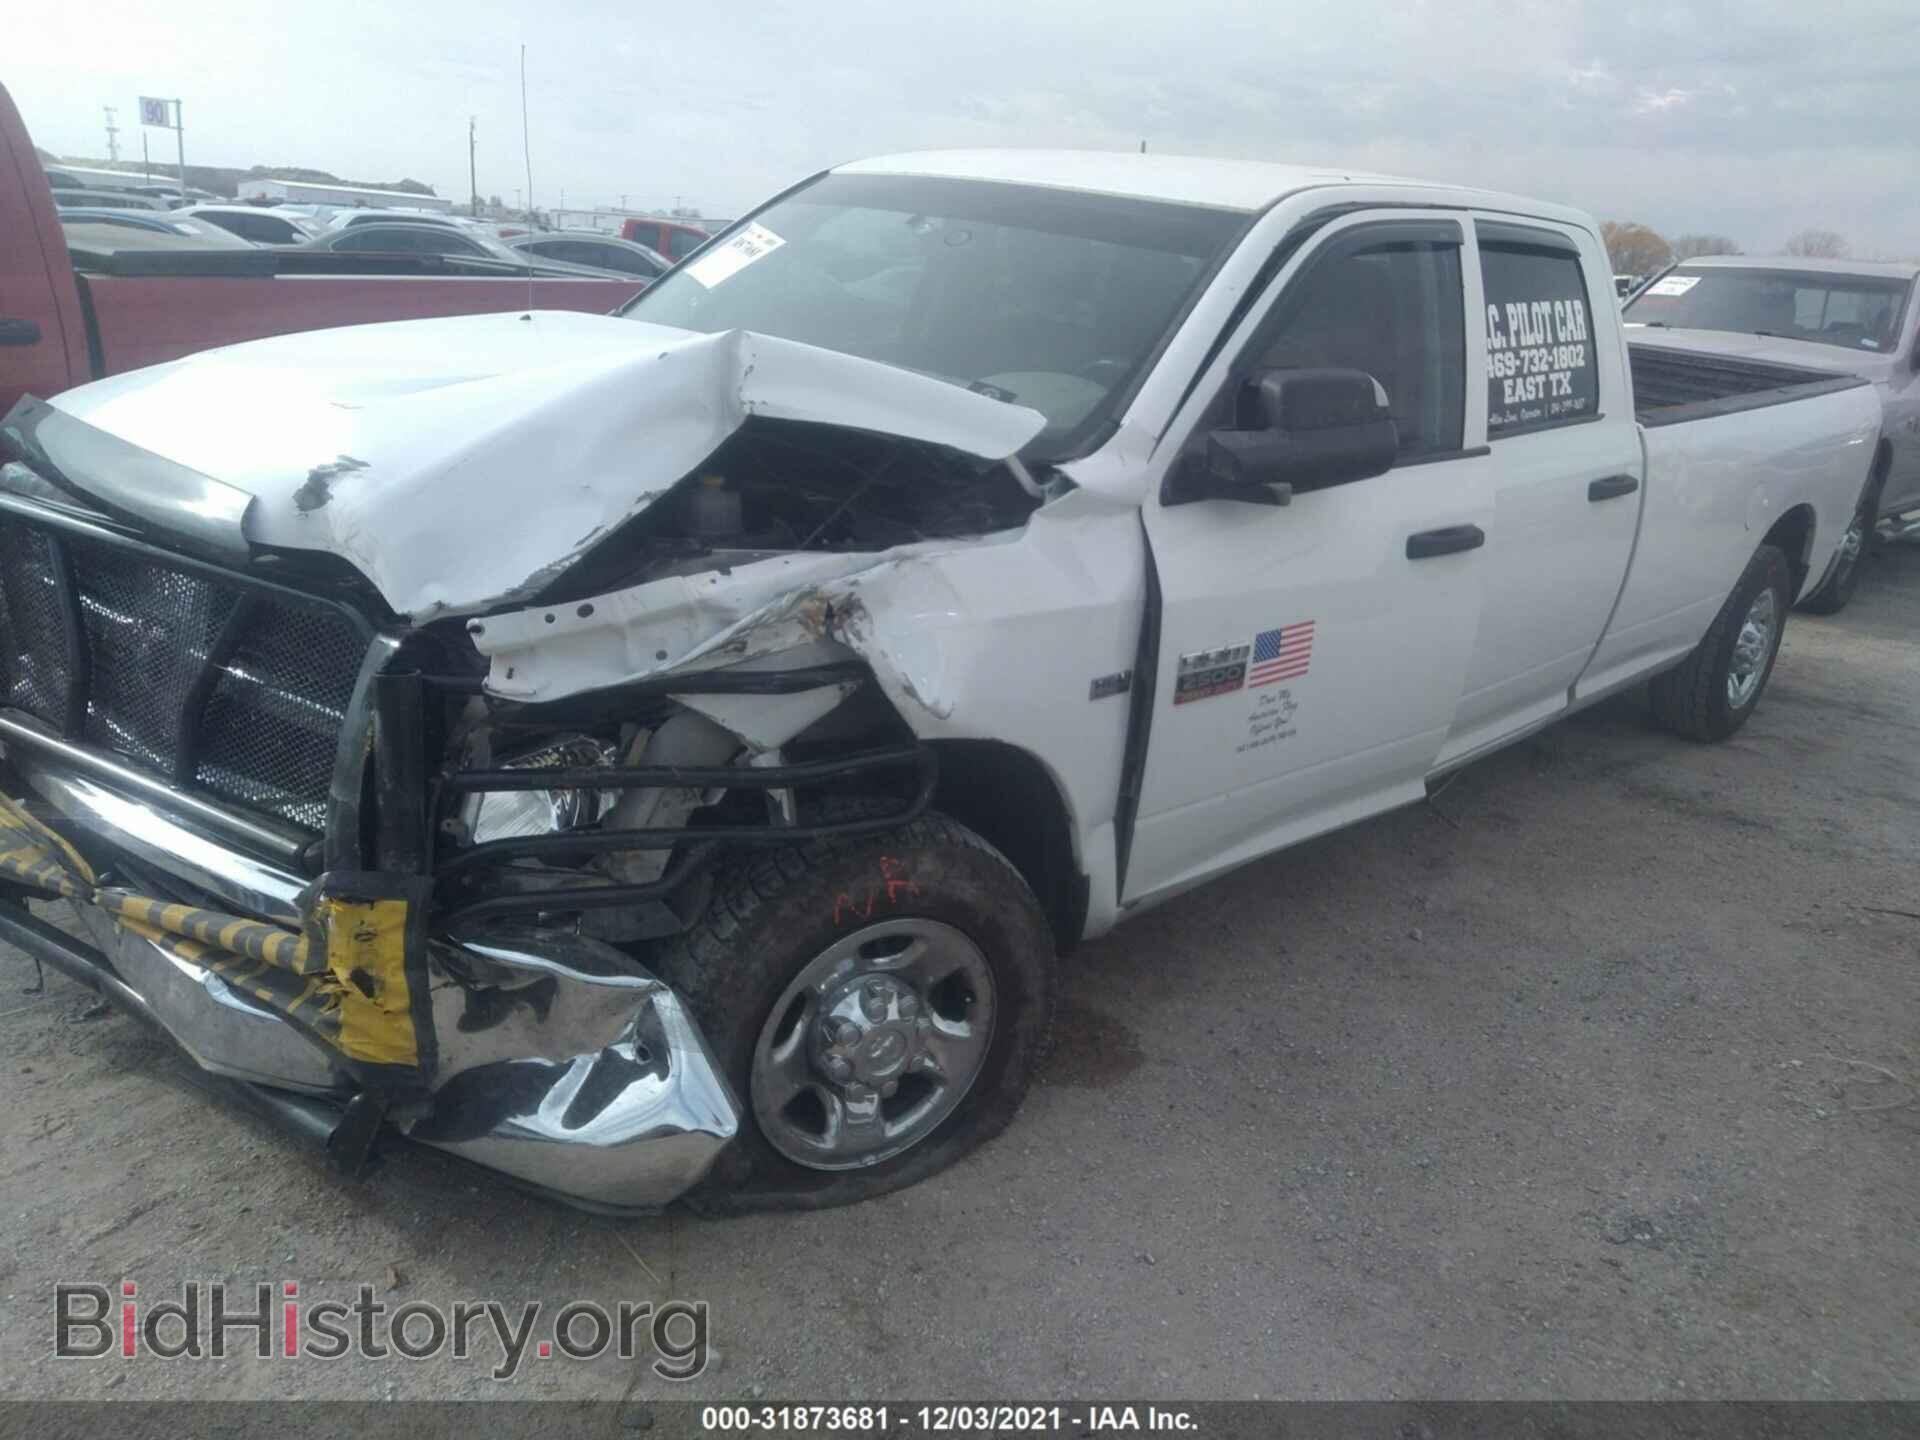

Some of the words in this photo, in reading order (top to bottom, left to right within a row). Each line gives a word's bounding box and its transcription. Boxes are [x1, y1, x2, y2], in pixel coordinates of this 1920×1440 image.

[1505, 301, 1553, 348] PILOT
[1554, 299, 1587, 343] CAR
[1503, 374, 1546, 404] EAST
[1549, 371, 1572, 397] TX
